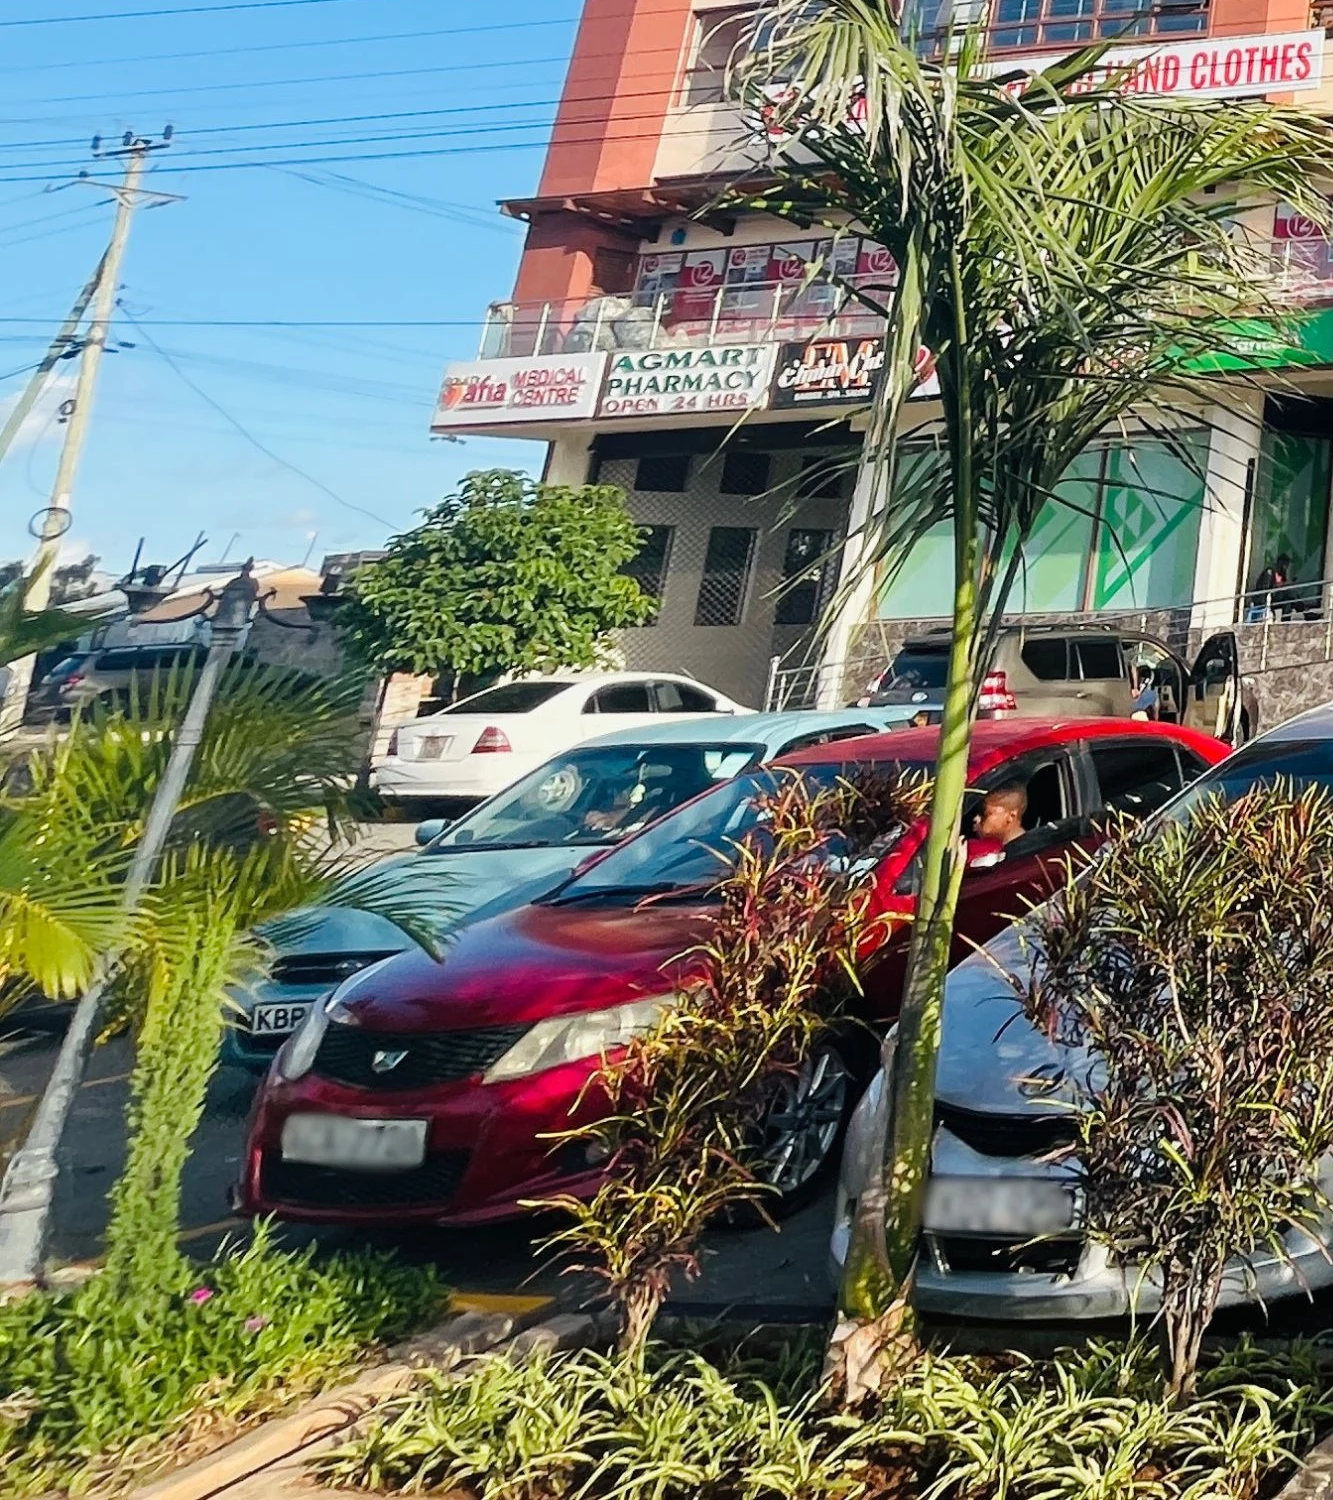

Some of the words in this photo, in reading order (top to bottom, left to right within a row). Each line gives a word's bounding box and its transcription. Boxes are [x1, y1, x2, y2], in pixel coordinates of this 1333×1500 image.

[1190, 42, 1313, 88] CLOTHES
[612, 347, 766, 373] AGMART
[513, 367, 587, 386] MEDICAL
[607, 369, 762, 396] PHARMACY
[511, 387, 579, 406] CENTRE
[603, 398, 659, 413] OPEN
[674, 396, 698, 410] 24
[256, 1007, 306, 1031] KBP
